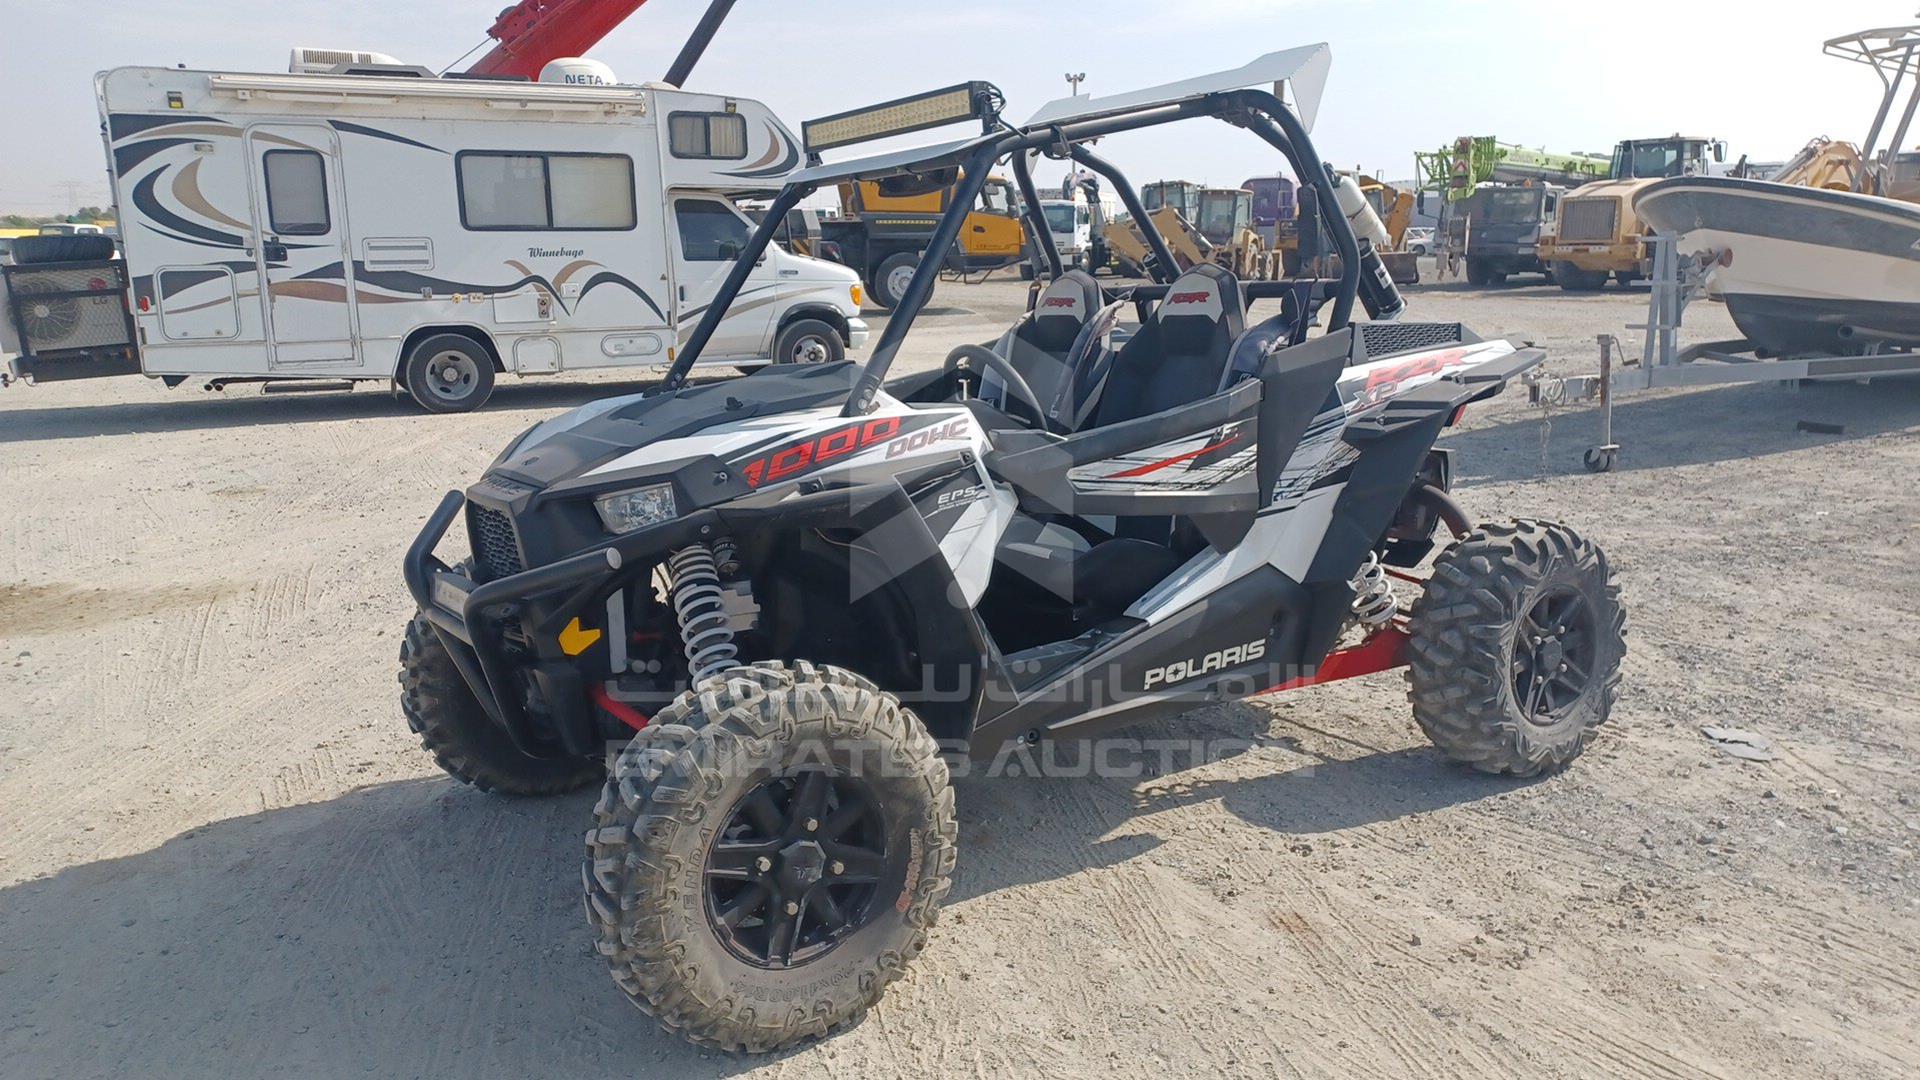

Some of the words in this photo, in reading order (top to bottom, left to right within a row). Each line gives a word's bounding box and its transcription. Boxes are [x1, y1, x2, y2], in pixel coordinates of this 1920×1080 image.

[527, 247, 584, 258] Winnebago
[1350, 380, 1399, 412] XP
[743, 415, 902, 489] 1000
[885, 417, 969, 460] DOHC
[937, 486, 977, 504] EPS
[1143, 638, 1266, 690] POLARIS
[684, 827, 712, 933] KENDA
